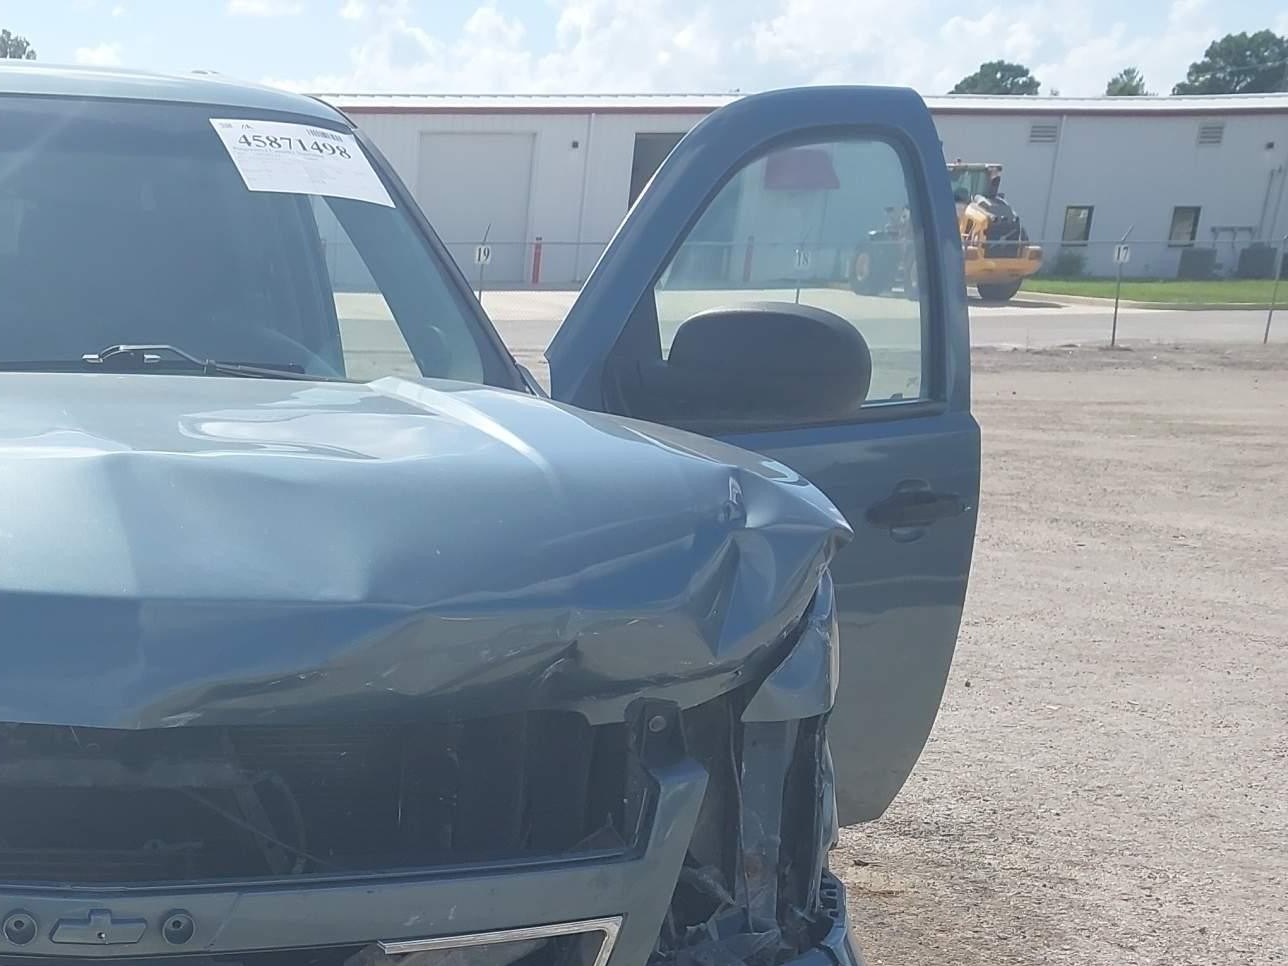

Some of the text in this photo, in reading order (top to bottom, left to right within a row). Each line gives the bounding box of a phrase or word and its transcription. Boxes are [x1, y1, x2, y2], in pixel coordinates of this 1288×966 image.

[238, 134, 352, 160] 45871498
[478, 247, 490, 261] 19
[1116, 246, 1128, 261] 17
